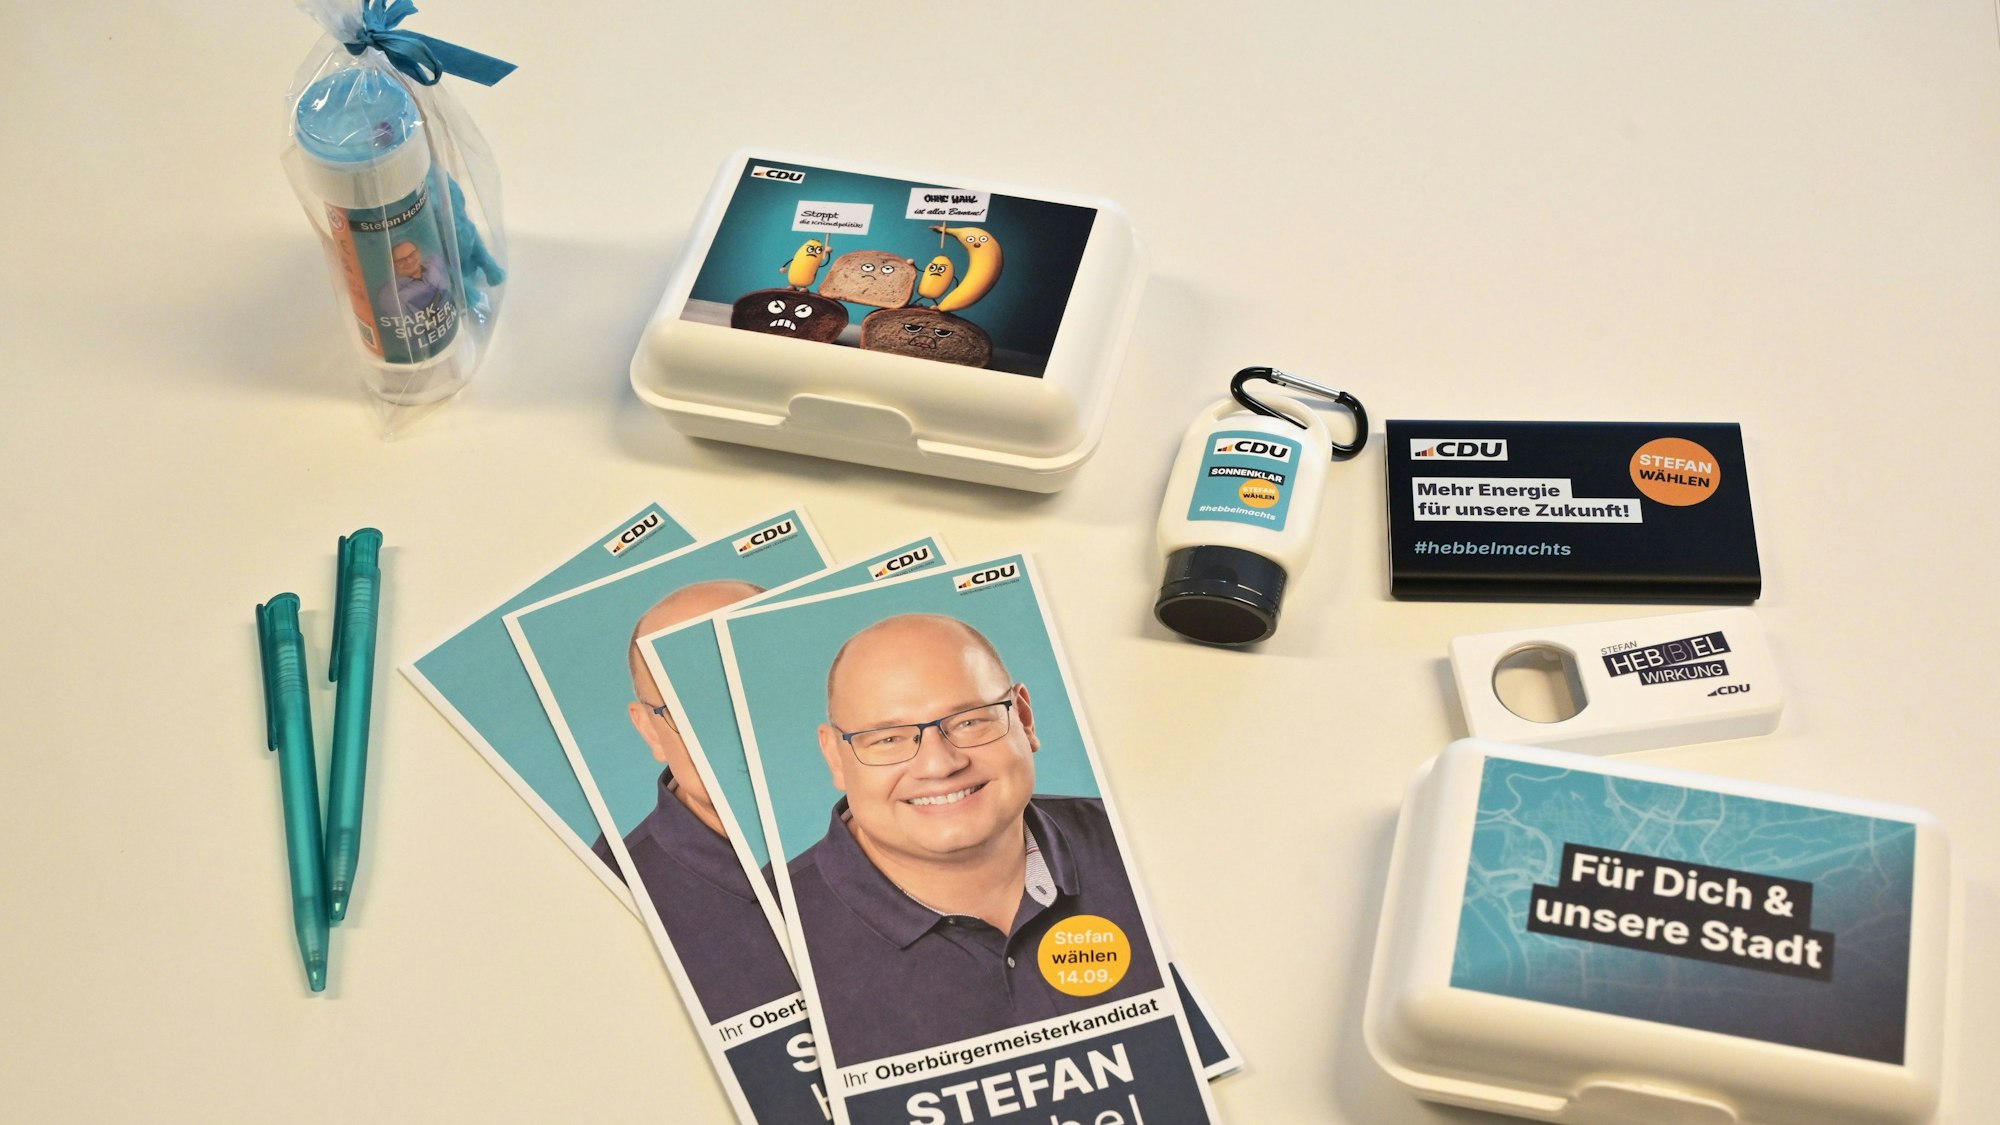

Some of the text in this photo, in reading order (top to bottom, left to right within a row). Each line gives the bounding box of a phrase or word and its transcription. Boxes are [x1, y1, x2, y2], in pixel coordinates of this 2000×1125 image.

[765, 170, 803, 182] CDU
[360, 217, 401, 231] Stefan
[800, 210, 839, 221] Stoppt
[380, 303, 440, 327] STARK.
[395, 301, 453, 339] SICHER.
[1235, 441, 1287, 457] CDU
[1435, 441, 1503, 458] CDU
[1639, 453, 1712, 474] STEFAN
[1211, 468, 1282, 482] SONNENKLAR
[1639, 469, 1710, 488] WÄHLEN
[1417, 482, 1561, 500] Mehr Energie
[1199, 505, 1276, 520] #hebbelmachts
[1418, 501, 1630, 518] für unsere Zukunft!
[620, 514, 658, 543] CDU
[750, 521, 792, 545] CDU
[1414, 540, 1571, 556] #hebbelmachts
[886, 548, 928, 571] CDU
[971, 565, 1015, 585] CDU
[1601, 640, 1637, 656] STEFAN
[1642, 663, 1724, 684] WIRKUNG
[1717, 683, 1751, 695] CDU
[1571, 851, 1794, 918] Für Dich &
[1055, 929, 1114, 945] Stefan
[1535, 897, 1823, 969] unsere Stadt
[1051, 949, 1117, 964] wählen
[1057, 968, 1113, 985] 14.09.
[719, 1023, 744, 1042] Ihr
[843, 1071, 869, 1088] Ihr
[874, 998, 1160, 1081] Oberbürgermeisterkandidat
[905, 1042, 1135, 1125] STEFAN
